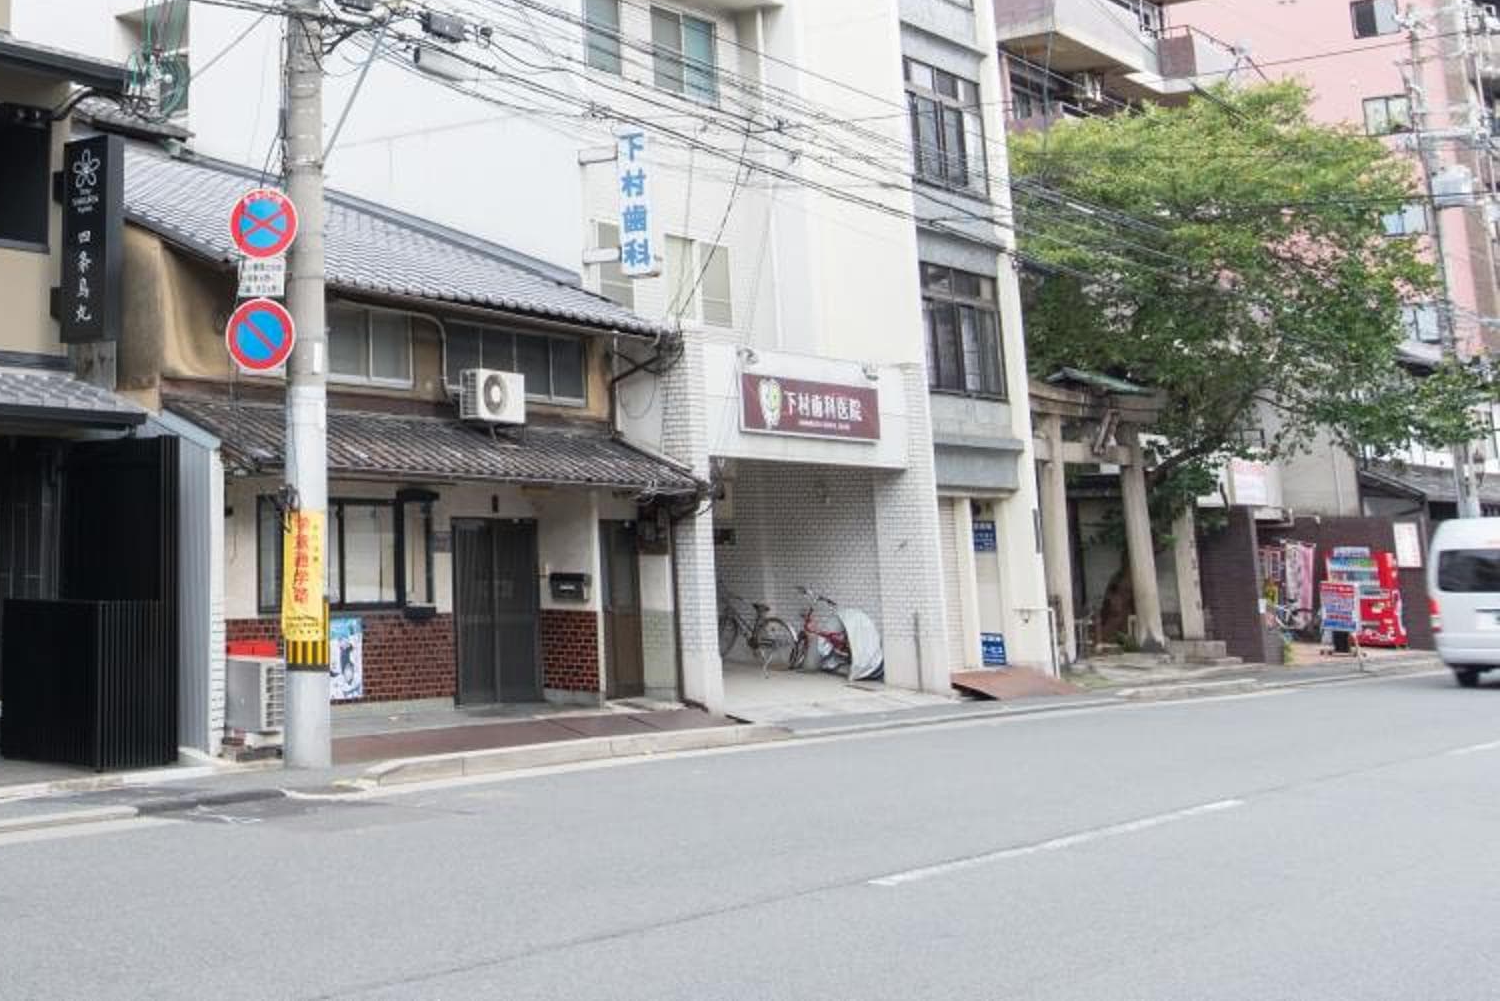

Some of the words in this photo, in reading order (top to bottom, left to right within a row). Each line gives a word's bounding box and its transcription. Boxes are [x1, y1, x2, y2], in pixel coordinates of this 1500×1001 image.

[618, 131, 650, 266] 下村歯科
[783, 390, 863, 422] 下村歯科医院
